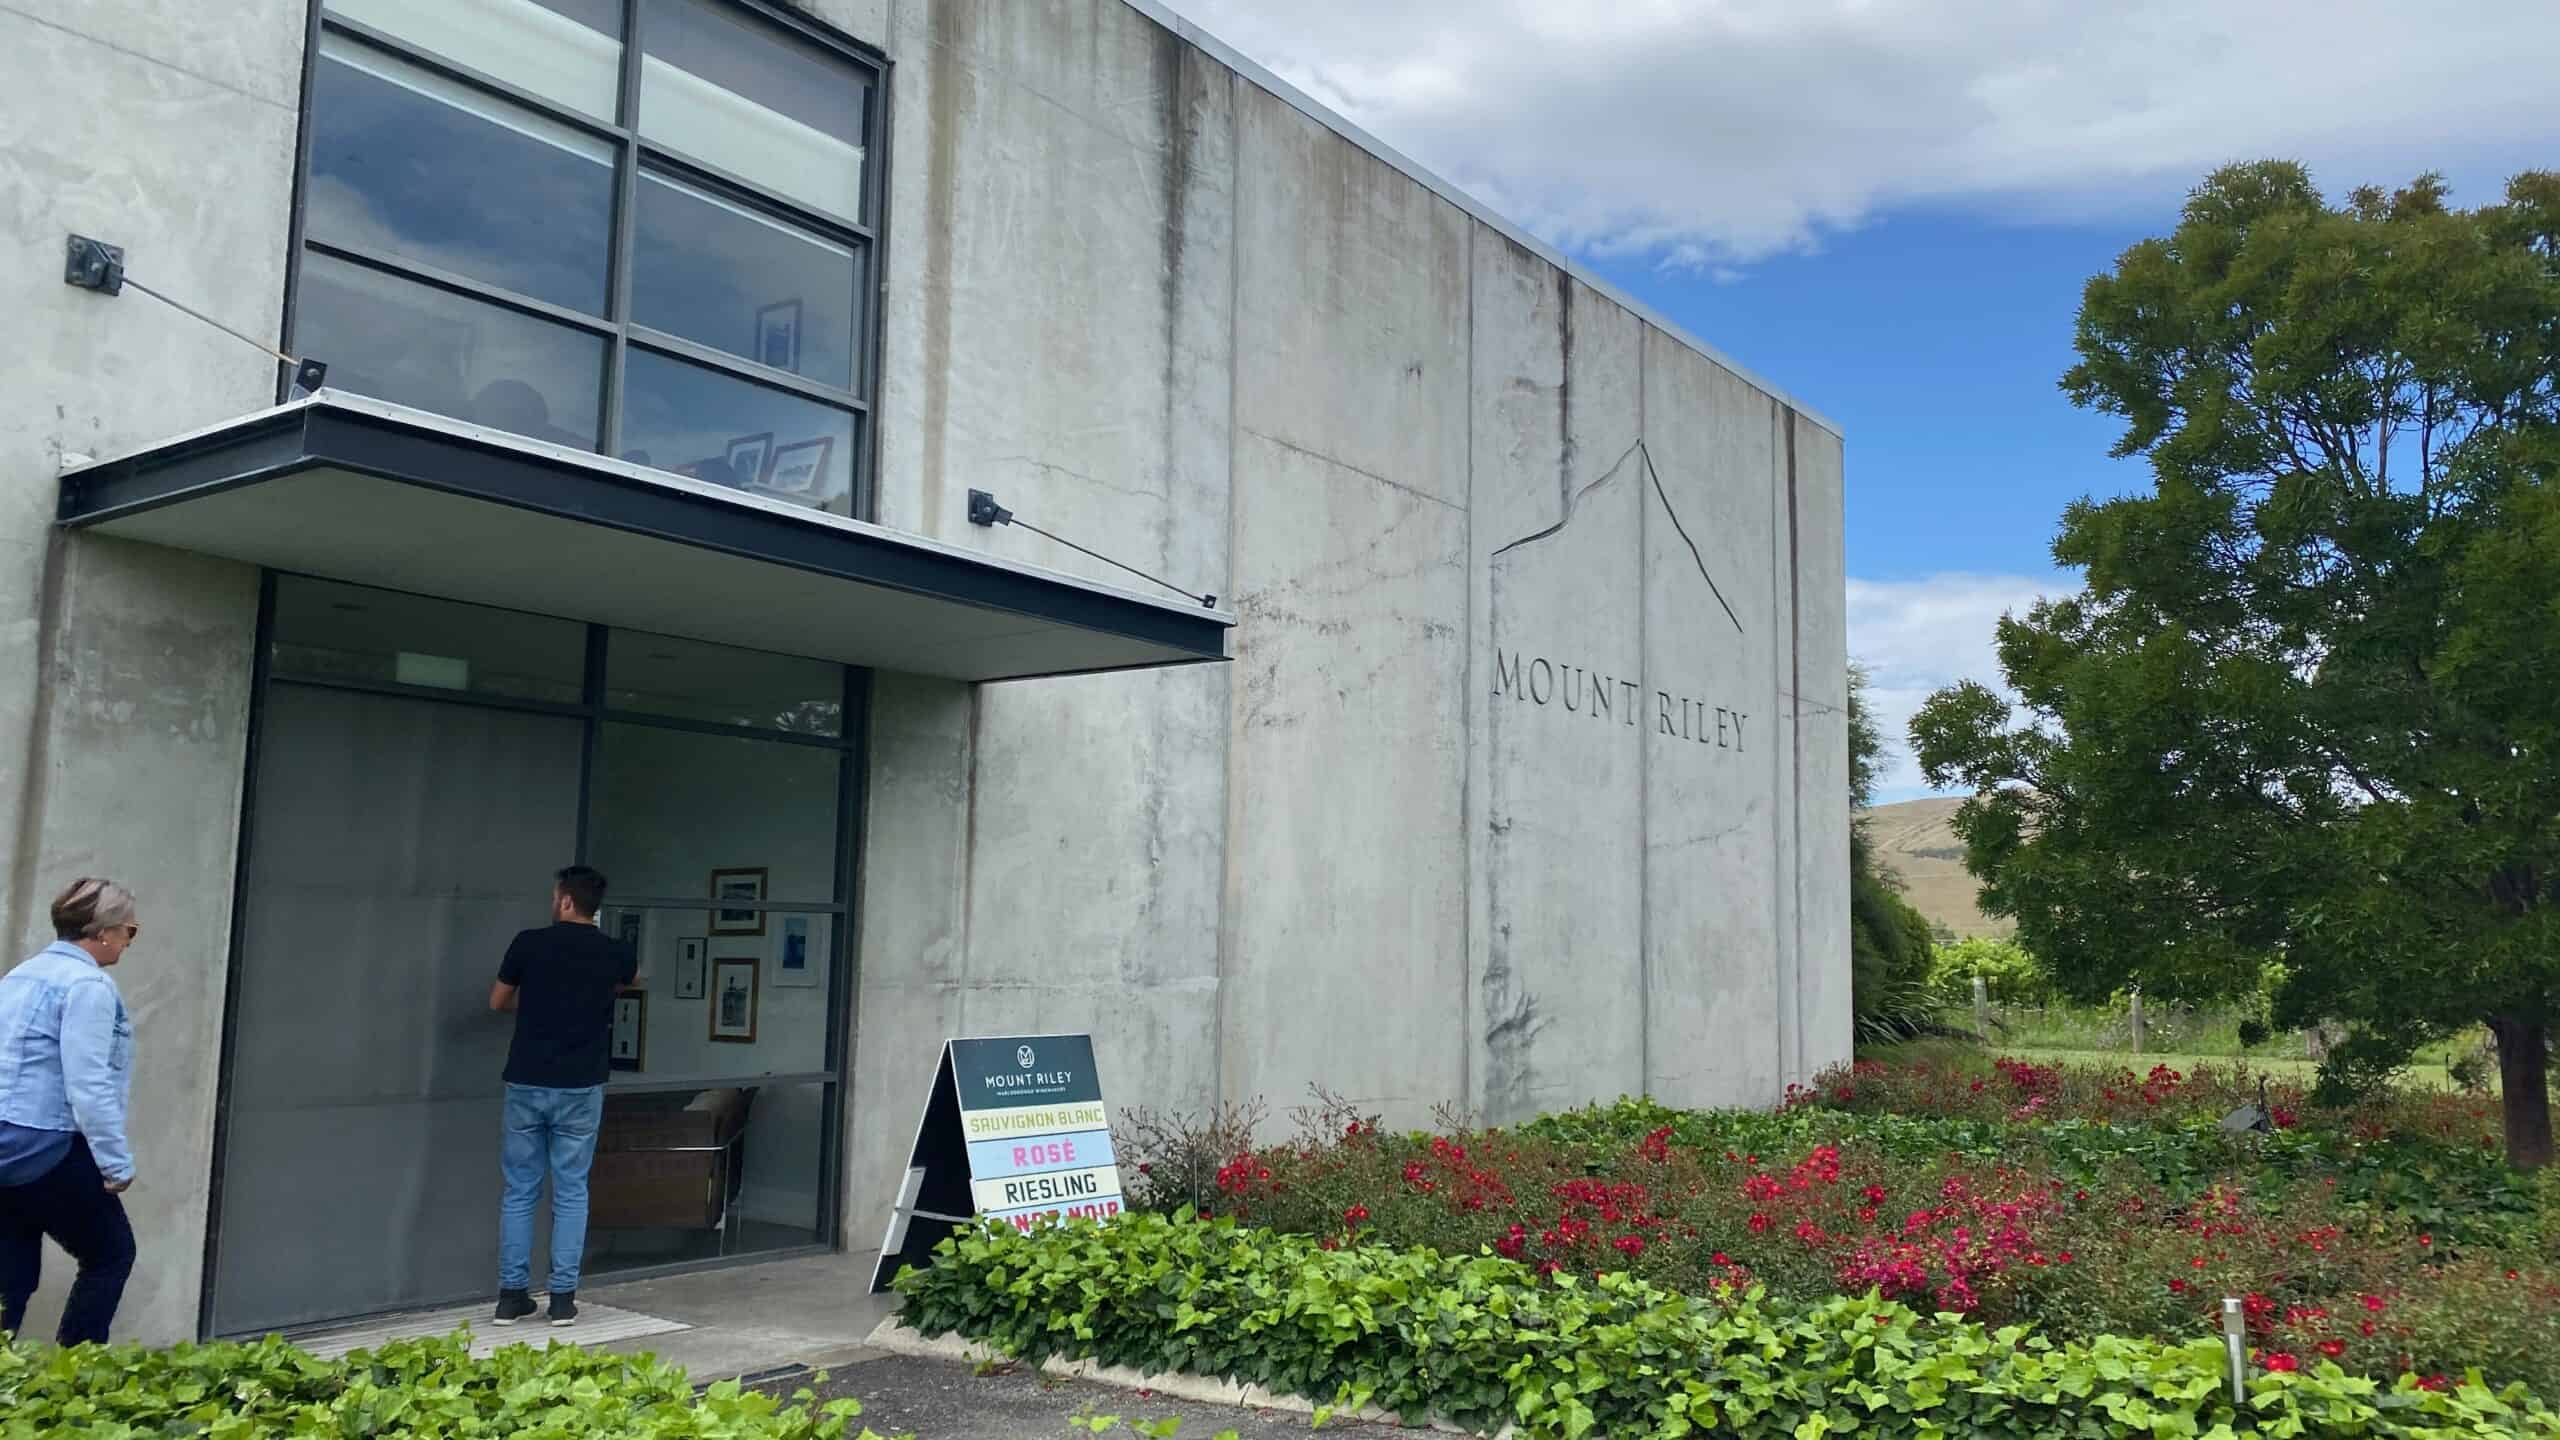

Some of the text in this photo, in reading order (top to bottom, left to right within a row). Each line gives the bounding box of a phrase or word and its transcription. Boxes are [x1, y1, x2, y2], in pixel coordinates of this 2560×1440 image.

[1493, 648, 1749, 752] MOUNT RILEY
[985, 1071, 1072, 1088] MOUNT RILEY
[970, 1108, 1103, 1133] SAUVIGNON BLANC
[1013, 1138, 1077, 1168] ROSÉ
[1005, 1173, 1097, 1204] RIESLING
